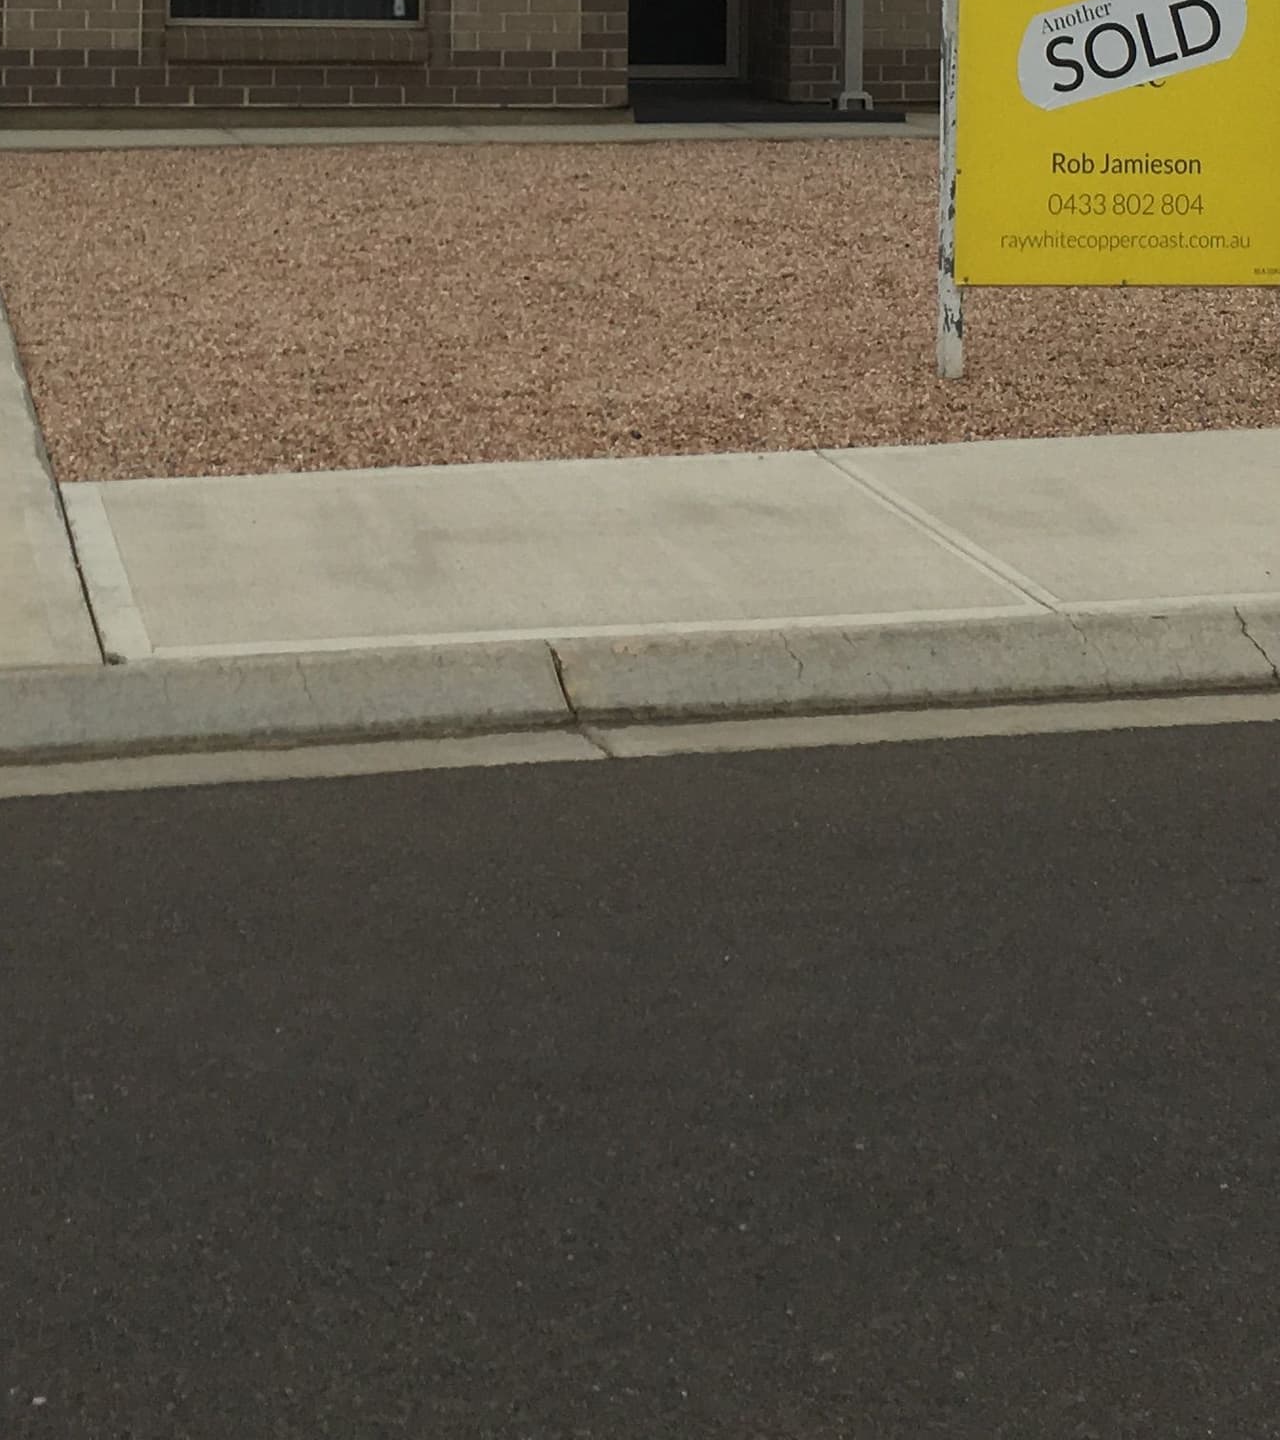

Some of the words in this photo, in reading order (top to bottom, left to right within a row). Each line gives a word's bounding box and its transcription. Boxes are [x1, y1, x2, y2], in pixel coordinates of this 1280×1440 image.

[1041, 2, 1112, 34] Another
[1052, 153, 1094, 174] Rob
[1100, 153, 1201, 175] Jamieson
[1048, 193, 1106, 215] 0433
[1112, 193, 1154, 215] 802
[1161, 193, 1204, 215] 804
[1001, 230, 1251, 252] raywhitecoppercoast.com.au
